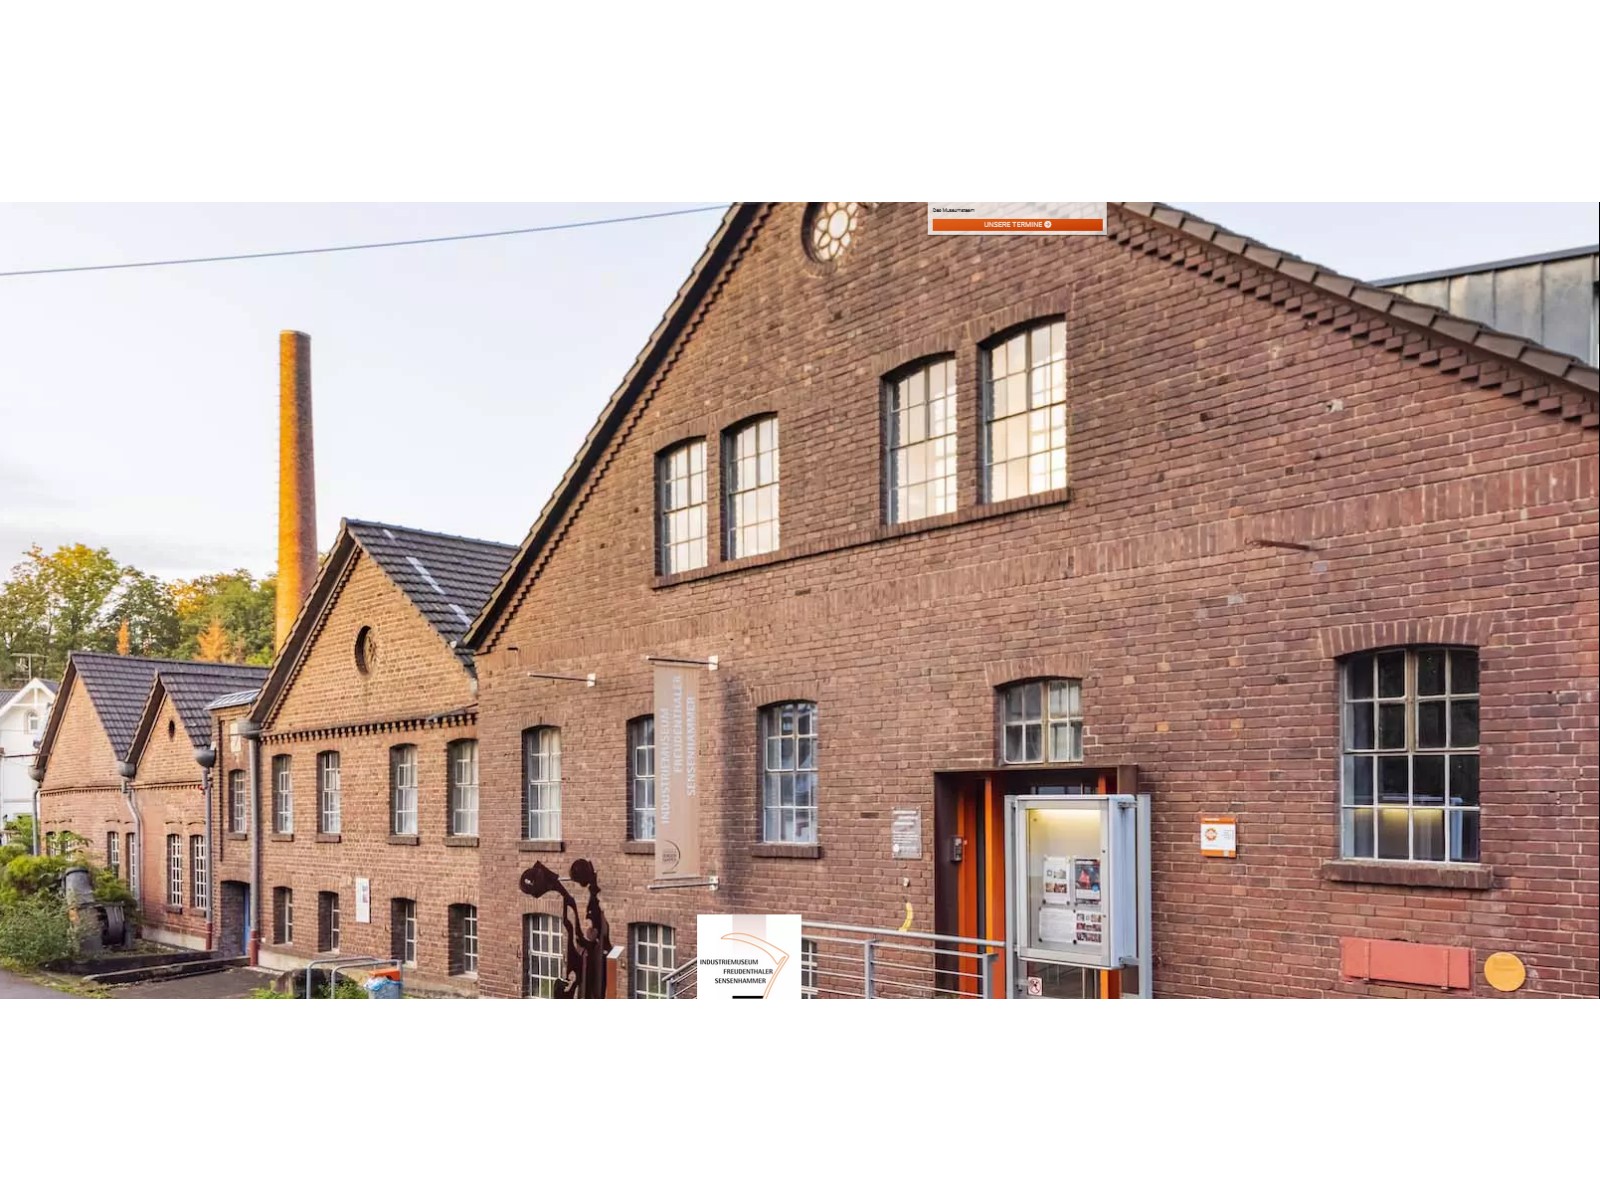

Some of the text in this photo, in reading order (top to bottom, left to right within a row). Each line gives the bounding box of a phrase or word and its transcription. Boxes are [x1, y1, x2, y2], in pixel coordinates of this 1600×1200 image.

[659, 707, 671, 825] INDUSTRIEMUSEUM
[672, 675, 683, 773] FREUDENTHALER
[686, 696, 696, 797] SENSENHAMMER
